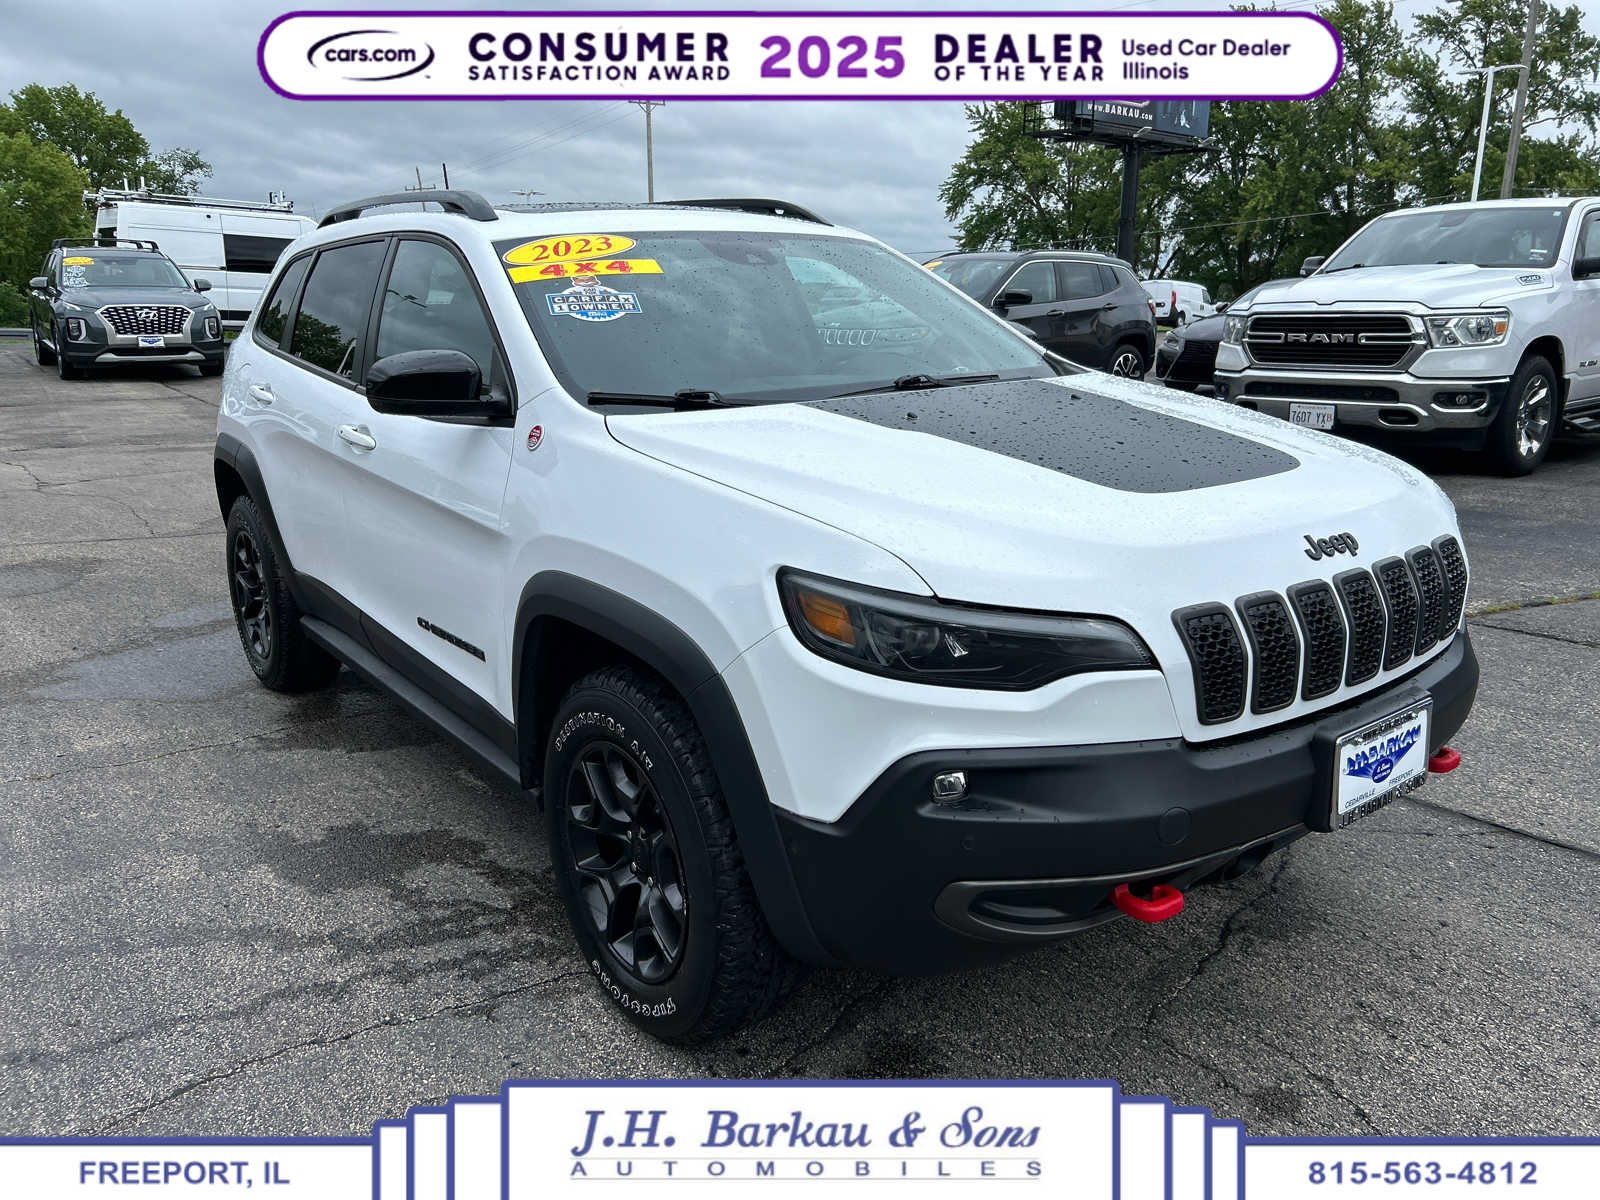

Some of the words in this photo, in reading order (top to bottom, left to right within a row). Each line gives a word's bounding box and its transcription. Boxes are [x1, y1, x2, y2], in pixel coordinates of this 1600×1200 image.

[532, 236, 613, 262] 2023
[553, 295, 633, 303] CARFAX
[558, 304, 565, 312] 1
[569, 302, 636, 312] OWNER
[1287, 333, 1354, 344] RAM
[1291, 410, 1312, 424] 7607
[1303, 532, 1359, 561] Jeep
